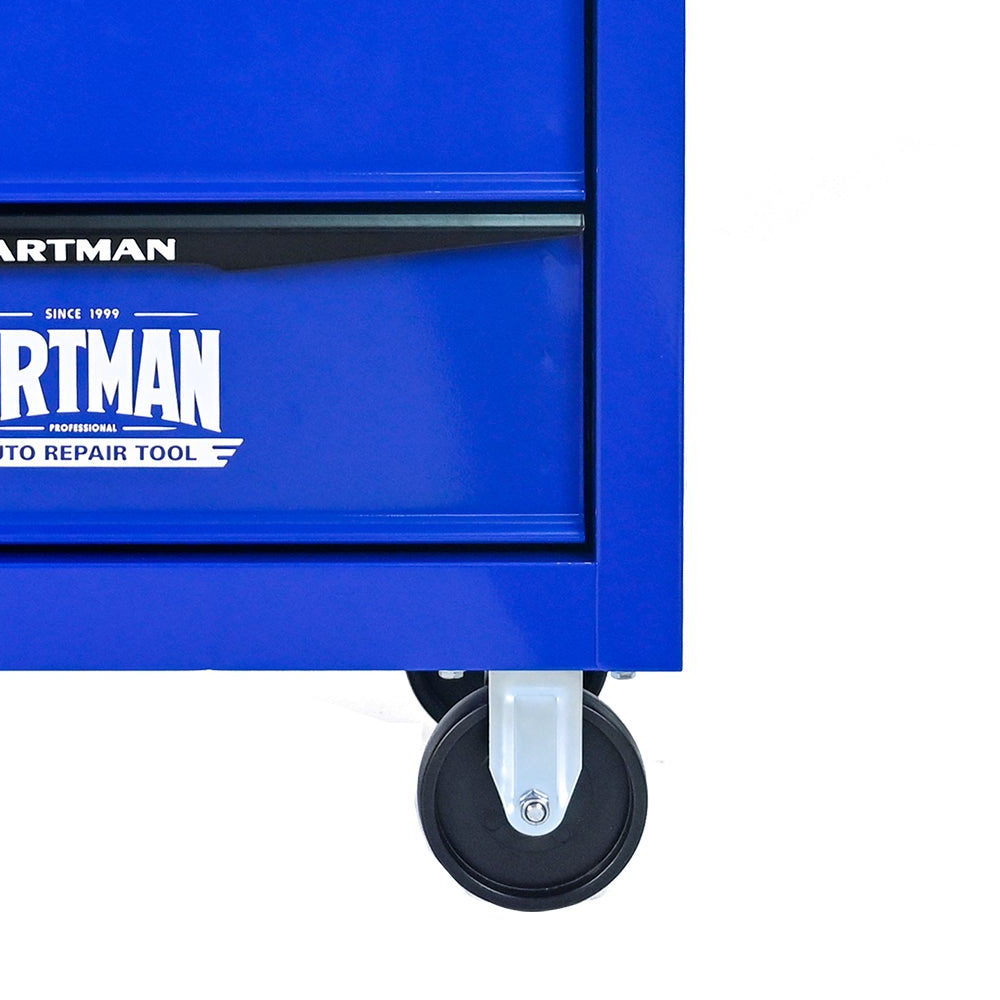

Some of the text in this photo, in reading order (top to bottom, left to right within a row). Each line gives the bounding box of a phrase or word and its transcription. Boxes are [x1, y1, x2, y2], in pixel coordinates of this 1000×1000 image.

[45, 308, 120, 320] SINCE 1999
[49, 423, 117, 433] PROFESSIONAL
[44, 445, 127, 461] REPAIR
[135, 445, 198, 461] TOOL
